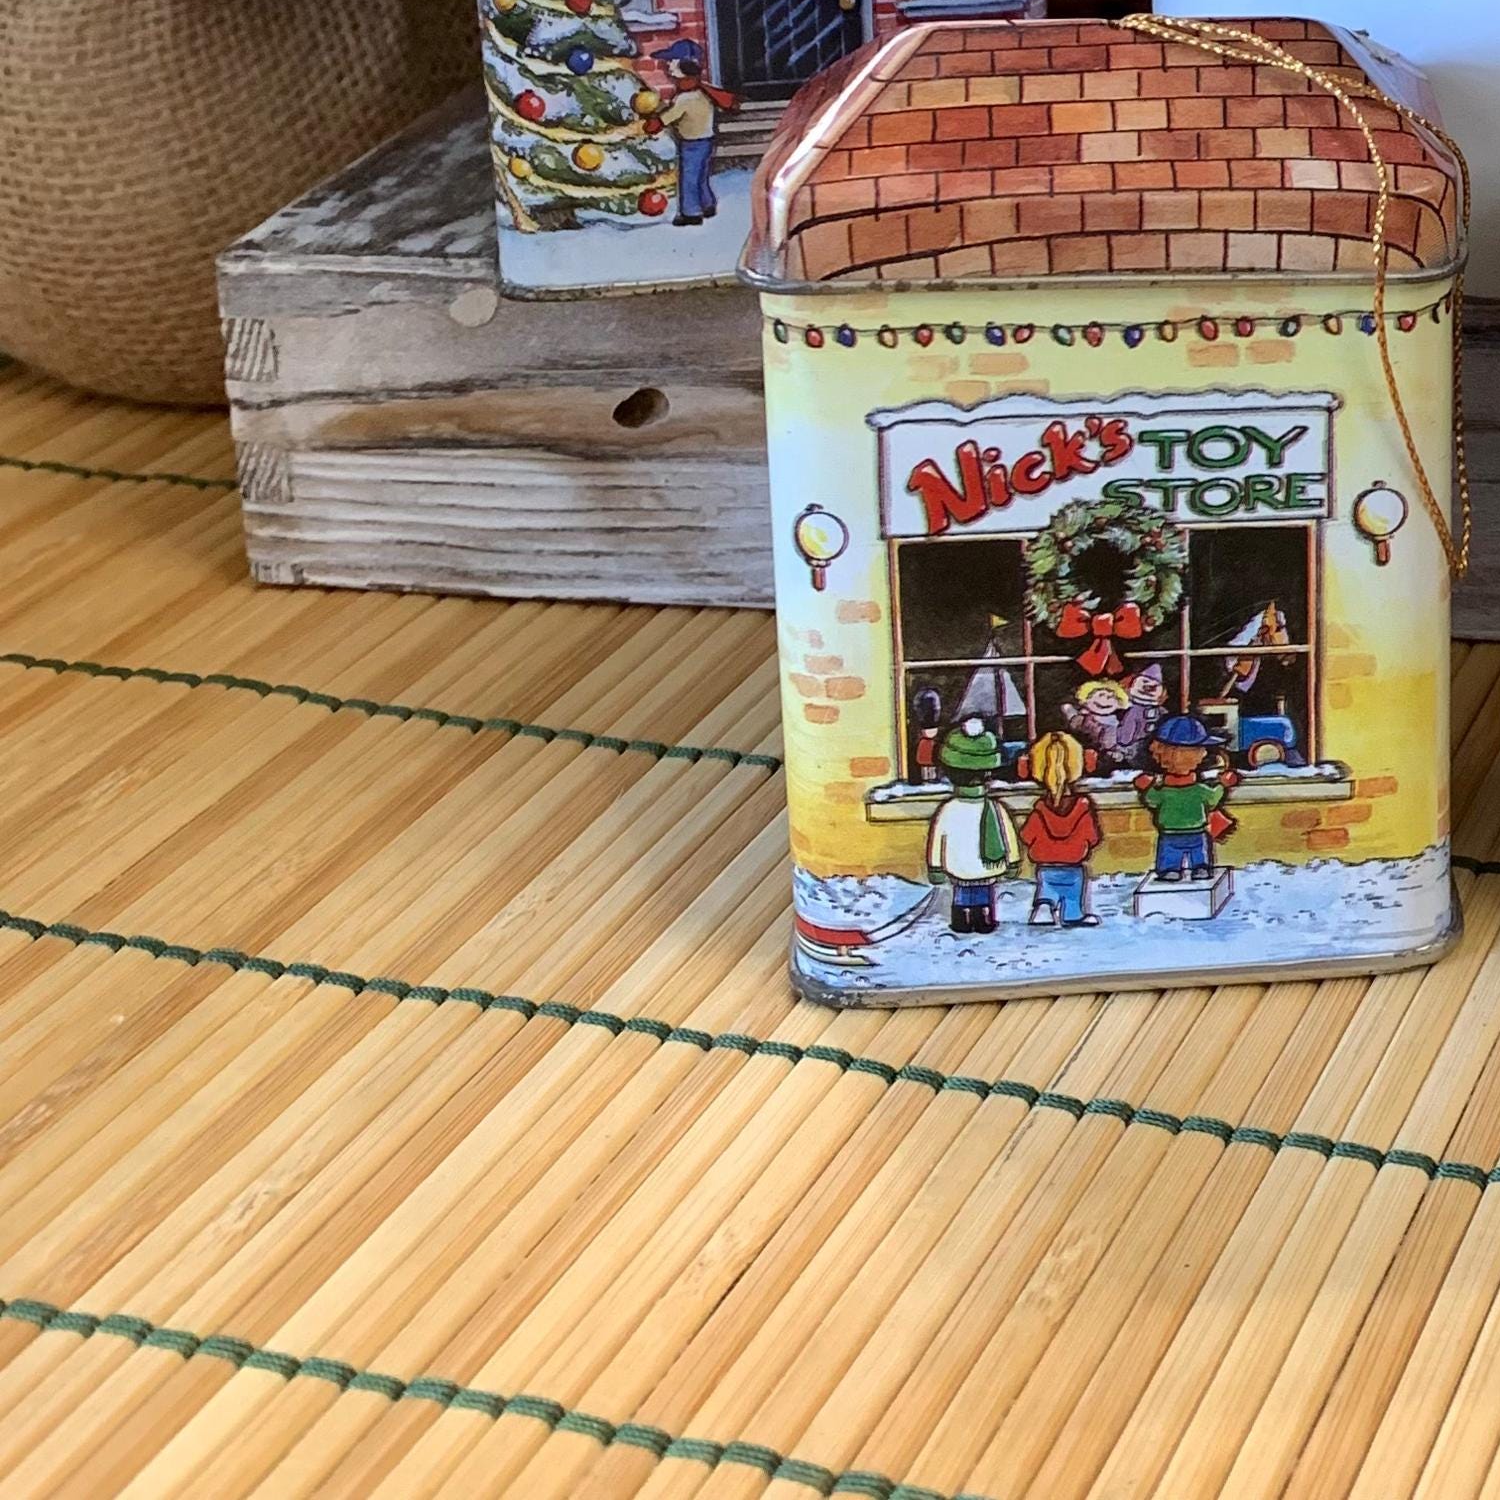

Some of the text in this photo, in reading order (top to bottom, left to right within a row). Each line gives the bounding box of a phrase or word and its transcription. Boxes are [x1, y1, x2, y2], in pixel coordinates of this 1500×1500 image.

[906, 416, 1310, 536] Nick's TOY
[1101, 472, 1327, 518] STORE
